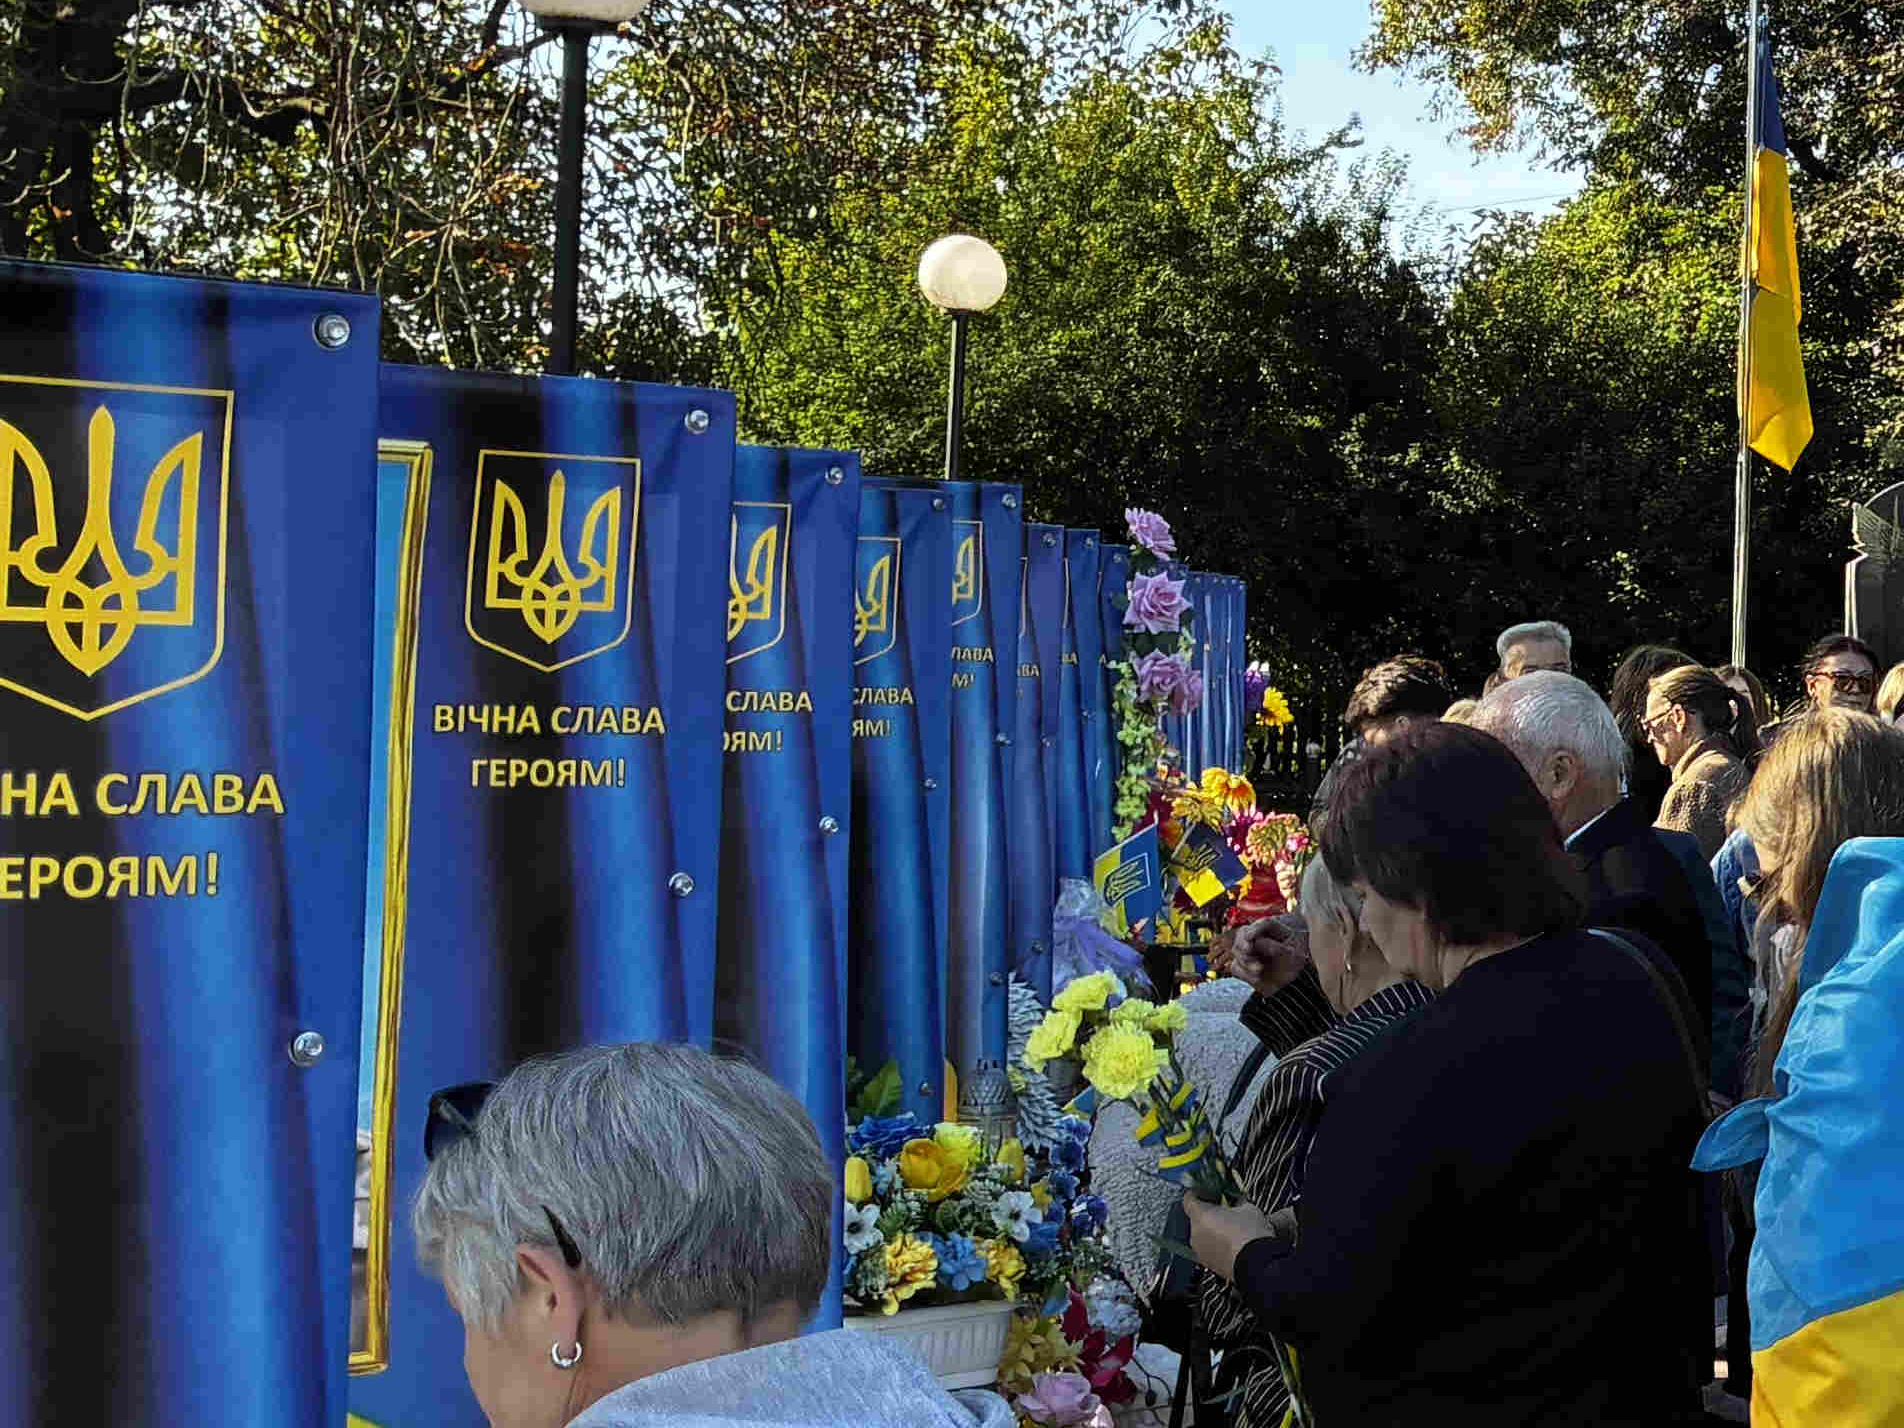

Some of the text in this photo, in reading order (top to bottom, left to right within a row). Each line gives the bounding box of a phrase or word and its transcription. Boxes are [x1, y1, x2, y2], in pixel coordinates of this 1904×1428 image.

[726, 690, 813, 712] СЛАВА
[434, 704, 665, 734] ВІЧНА СЛАВА
[472, 758, 625, 788] ГЕРОЯМ!
[95, 772, 285, 815] СЛАВА
